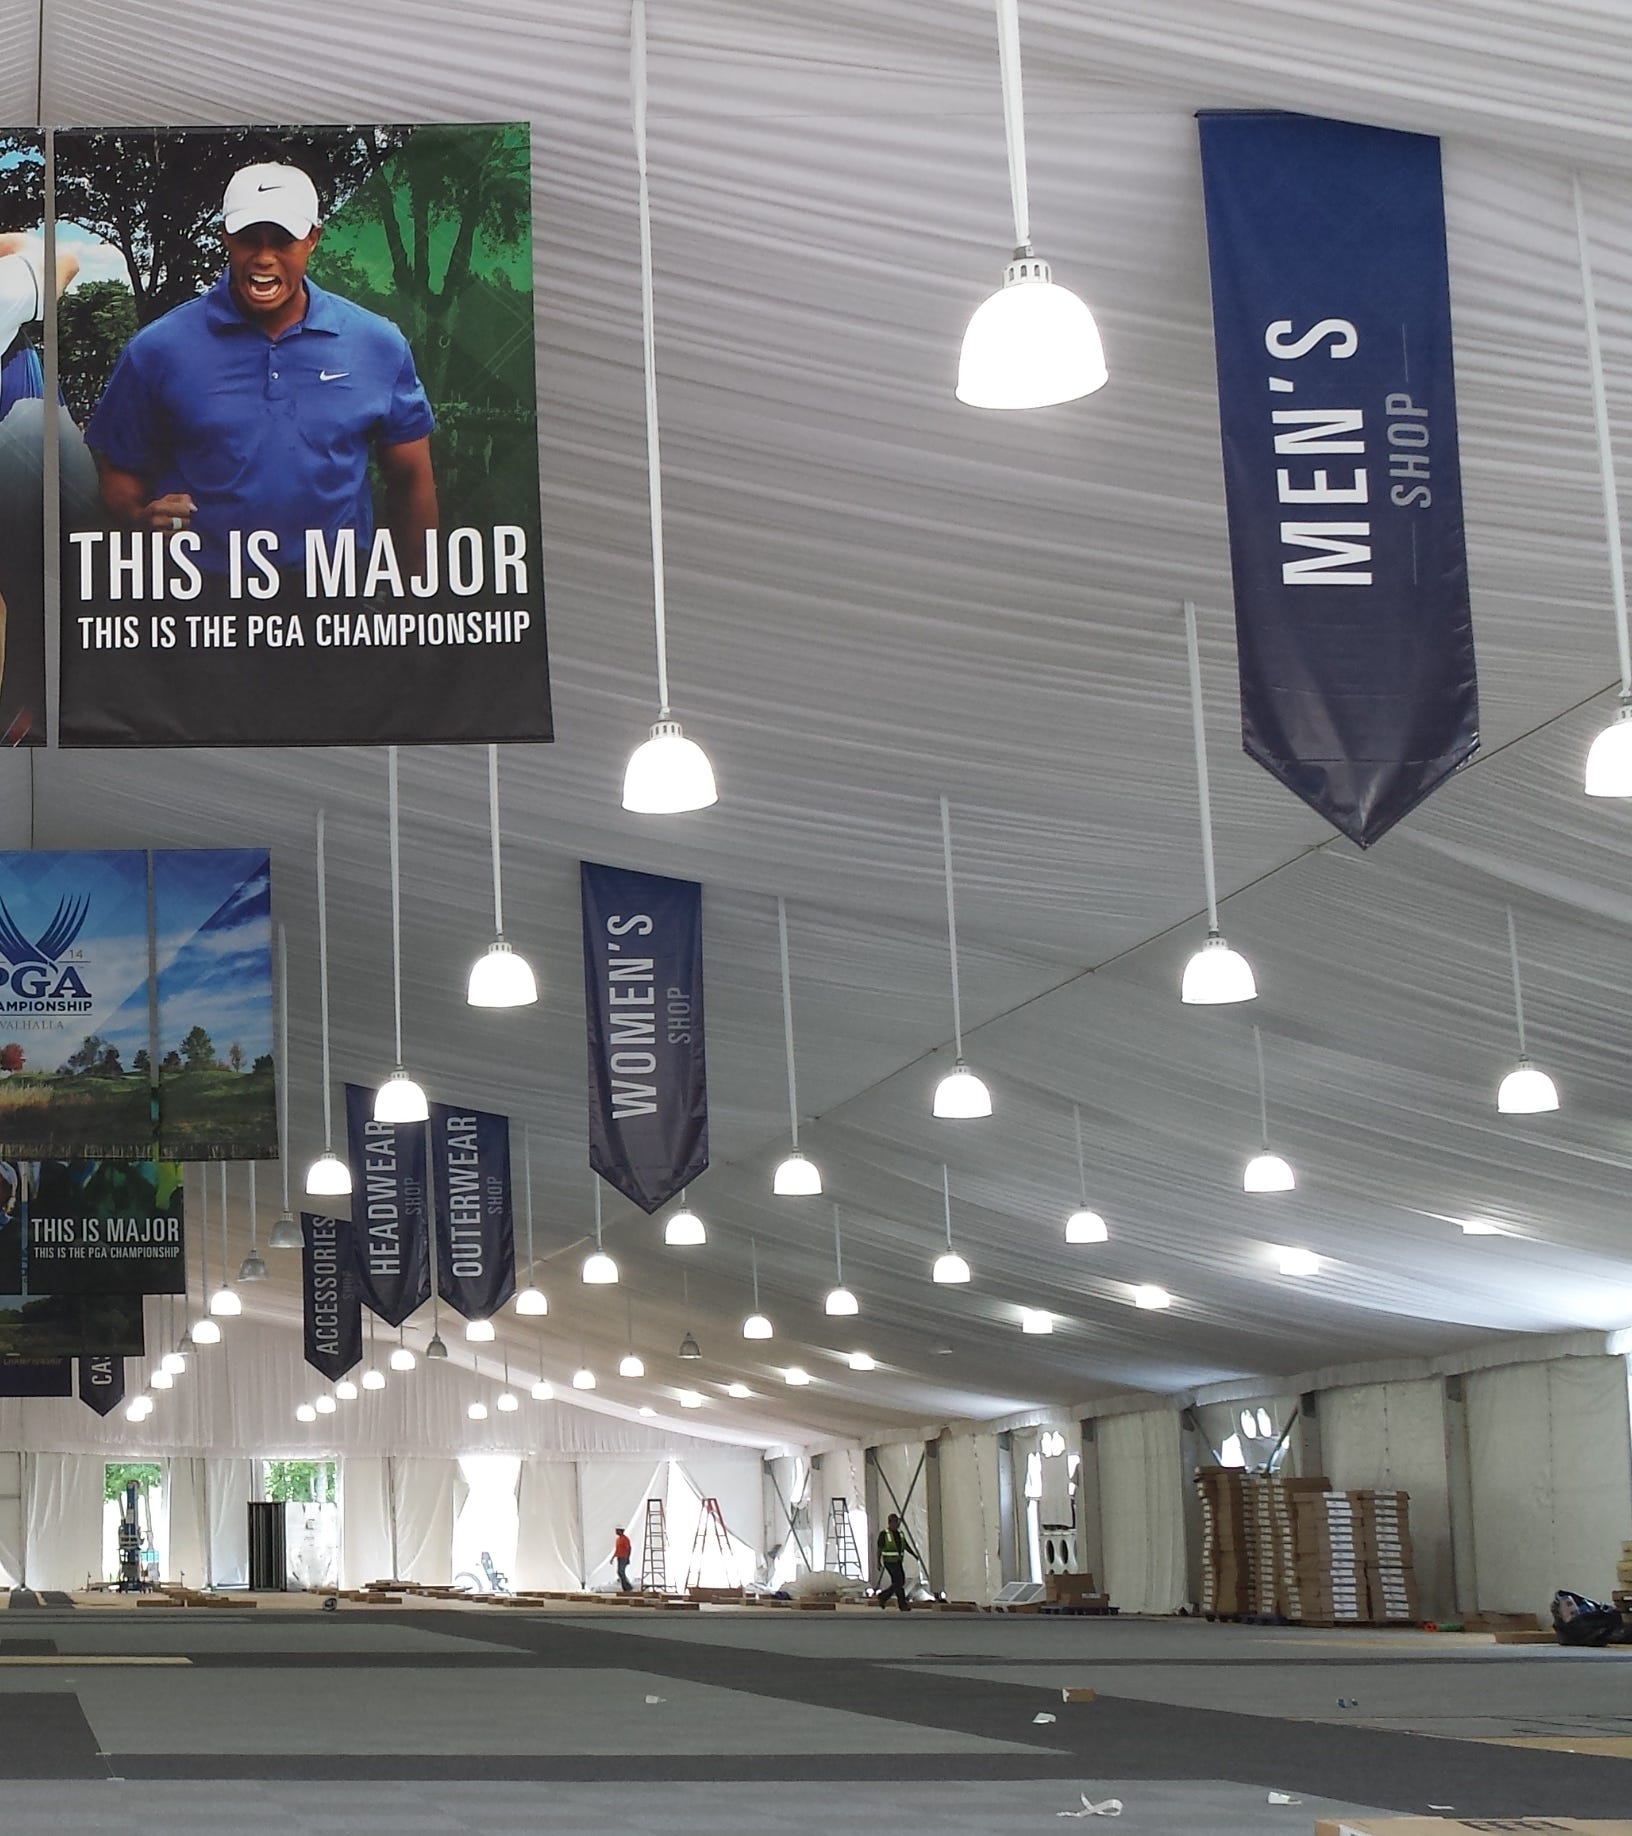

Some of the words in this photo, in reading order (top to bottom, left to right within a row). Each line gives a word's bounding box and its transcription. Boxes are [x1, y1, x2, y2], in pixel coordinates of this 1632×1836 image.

[1265, 318, 1373, 585] MEN'S
[1385, 392, 1431, 509] SHOP
[69, 531, 202, 601] THIS
[229, 529, 280, 600] IS
[304, 525, 529, 599] MAJOR
[78, 617, 139, 649] THIS
[151, 616, 176, 649] IS
[185, 615, 237, 648] THE
[248, 614, 305, 648] PGA
[316, 610, 530, 648] CHAMPIONSHIP
[69, 949, 83, 959] 14
[0, 1020, 64, 1031] VALHALLA
[607, 914, 657, 1119] WOMEN'S
[667, 987, 691, 1045] SHOP
[364, 1121, 401, 1275] HEADWEAR
[404, 1177, 422, 1216] SHOP
[447, 1116, 483, 1278] OUTERWEAR
[487, 1176, 504, 1215] SHOP
[31, 1218, 75, 1242] THIS
[82, 1218, 100, 1242] IS
[107, 1217, 179, 1242] MAJOR
[34, 1247, 54, 1259] THIS
[57, 1247, 66, 1259] IS
[69, 1247, 86, 1258] THE
[88, 1247, 107, 1258] PGA
[110, 1246, 180, 1258] CHAMPIONSHIP
[313, 1217, 339, 1355] ACCESSORIES
[91, 1356, 113, 1385] CA
